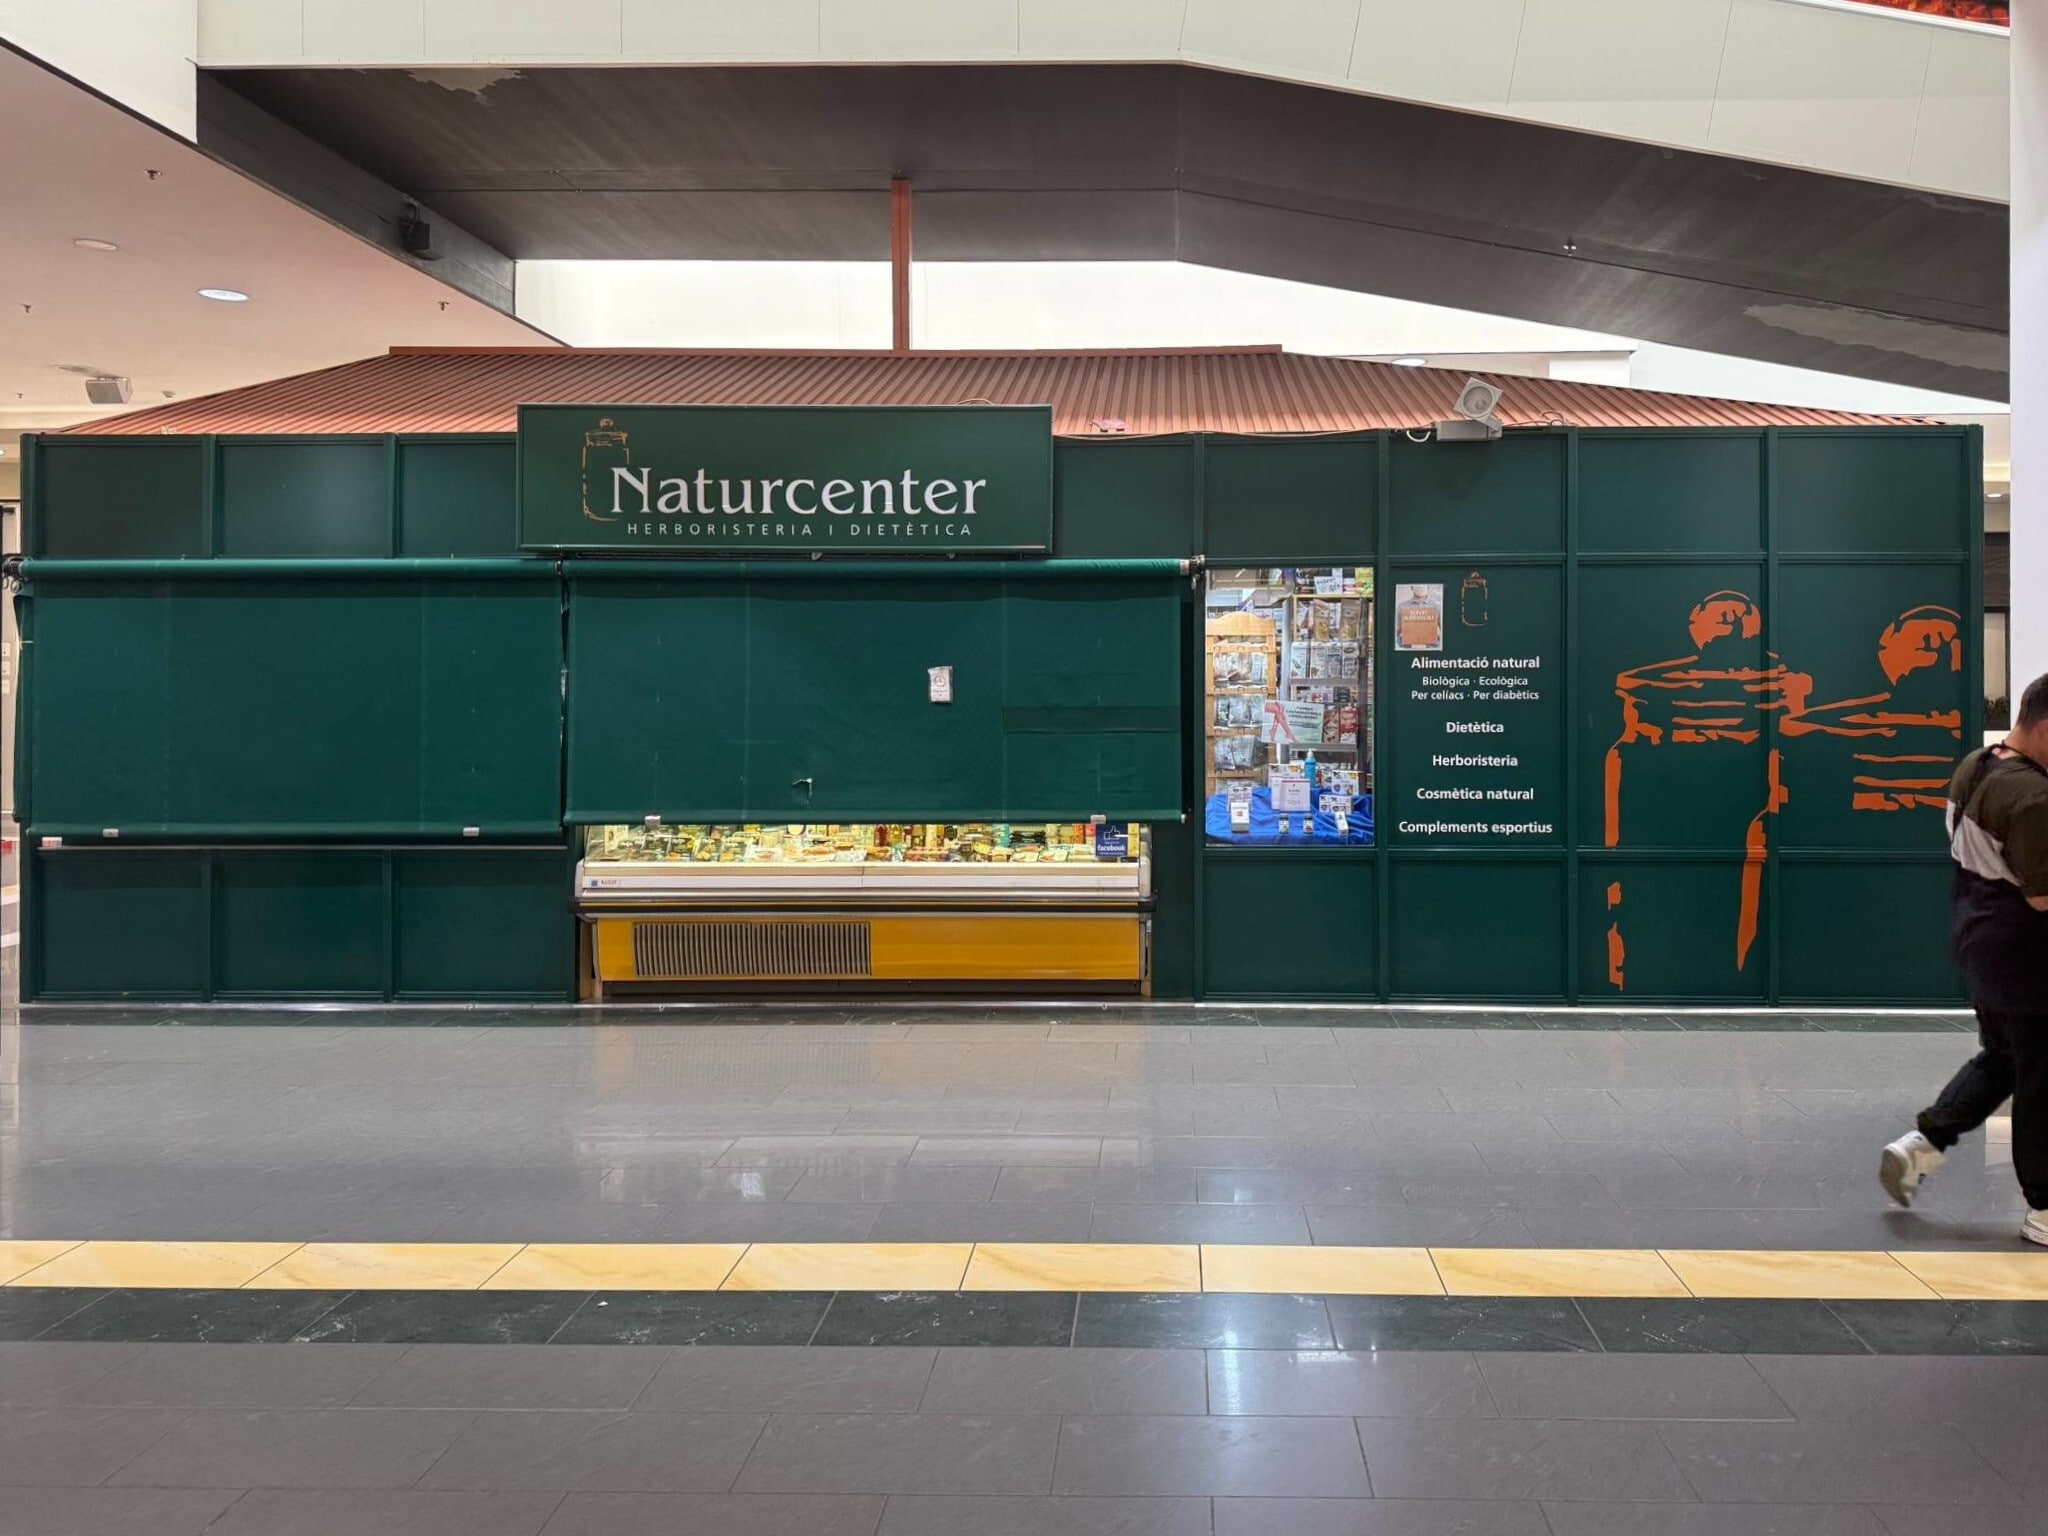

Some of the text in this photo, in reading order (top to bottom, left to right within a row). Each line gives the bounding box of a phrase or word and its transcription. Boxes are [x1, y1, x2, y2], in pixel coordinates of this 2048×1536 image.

[611, 467, 987, 515] Naturcenter
[627, 521, 971, 536] HERBORISTERIA I DIETÈTICA
[1410, 655, 1540, 669] Alimentació natural
[1422, 675, 1529, 689] Biològica Ecològica
[1411, 689, 1540, 701] Per celíacs Per diabètics
[1445, 720, 1505, 733] Dietètica
[1432, 753, 1519, 767] Herboristeria
[1416, 787, 1534, 800] Cosmètica natural
[1398, 820, 1553, 836] Complements esportius
